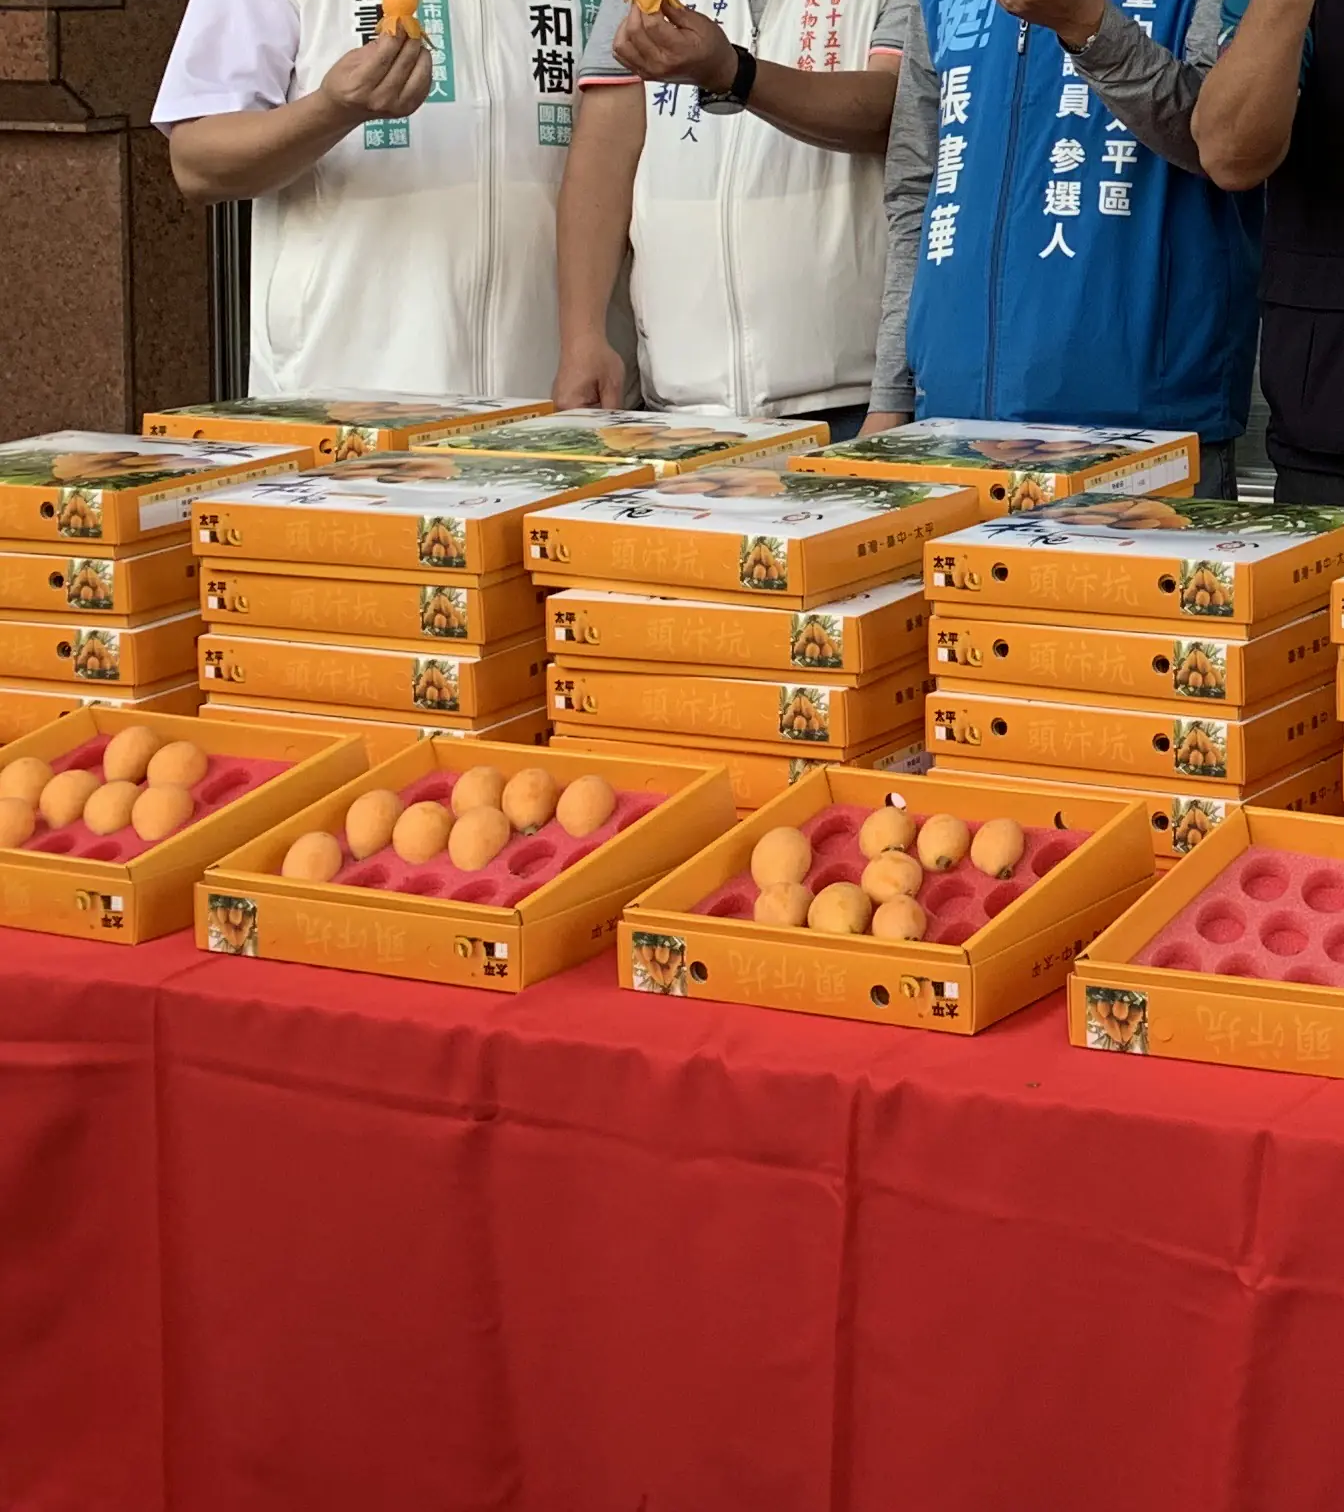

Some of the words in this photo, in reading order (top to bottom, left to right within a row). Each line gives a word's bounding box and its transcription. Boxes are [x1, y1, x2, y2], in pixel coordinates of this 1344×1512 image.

[926, 65, 972, 266] 張書華
[199, 514, 219, 527] 太平
[530, 529, 549, 543] 太平
[933, 555, 955, 569] 太平
[207, 580, 227, 594] 太平
[554, 611, 576, 627] 太平
[937, 631, 958, 645] 太平
[205, 650, 224, 663] 太平
[554, 679, 575, 694] 太平
[934, 709, 956, 724] 太平
